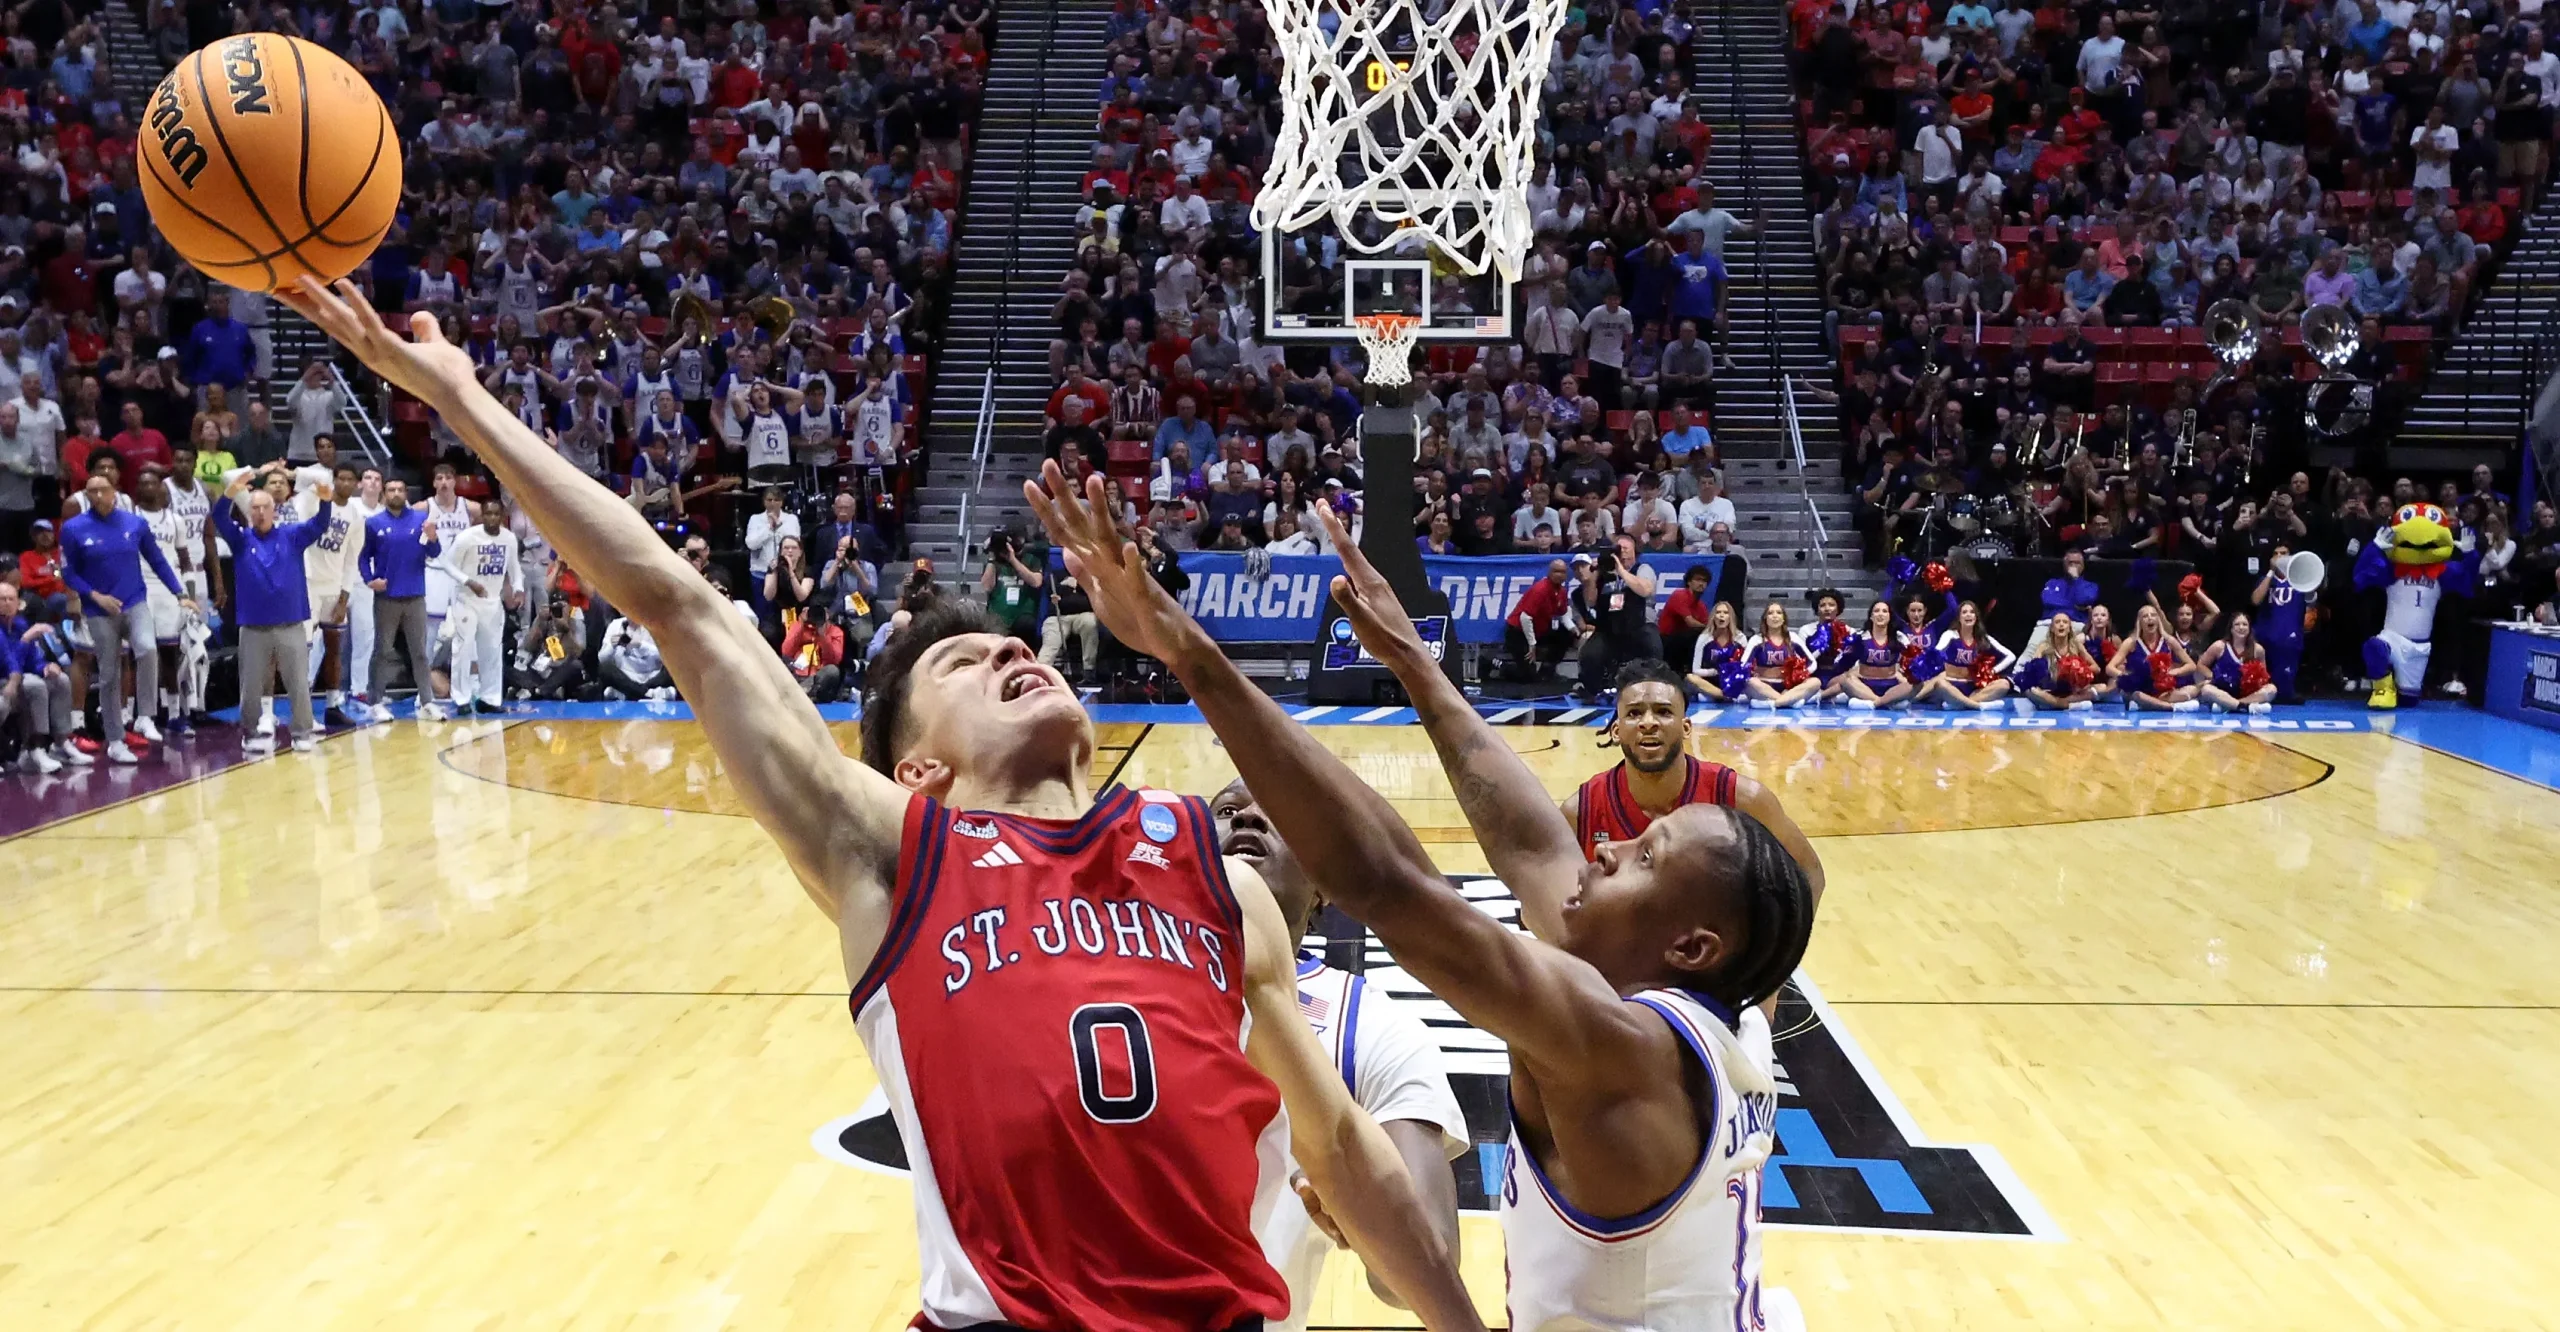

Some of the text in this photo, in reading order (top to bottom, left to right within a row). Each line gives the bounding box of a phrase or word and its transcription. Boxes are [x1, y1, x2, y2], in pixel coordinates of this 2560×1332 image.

[868, 416, 880, 432] 6
[766, 432, 778, 449] 6
[2268, 587, 2293, 606] KU
[1907, 634, 1932, 648] KU
[2083, 718, 2355, 729] ROUND
[1135, 841, 1164, 856] BIG
[941, 897, 1229, 995] ST. JOHN'S
[1068, 1001, 1159, 1125] 0
